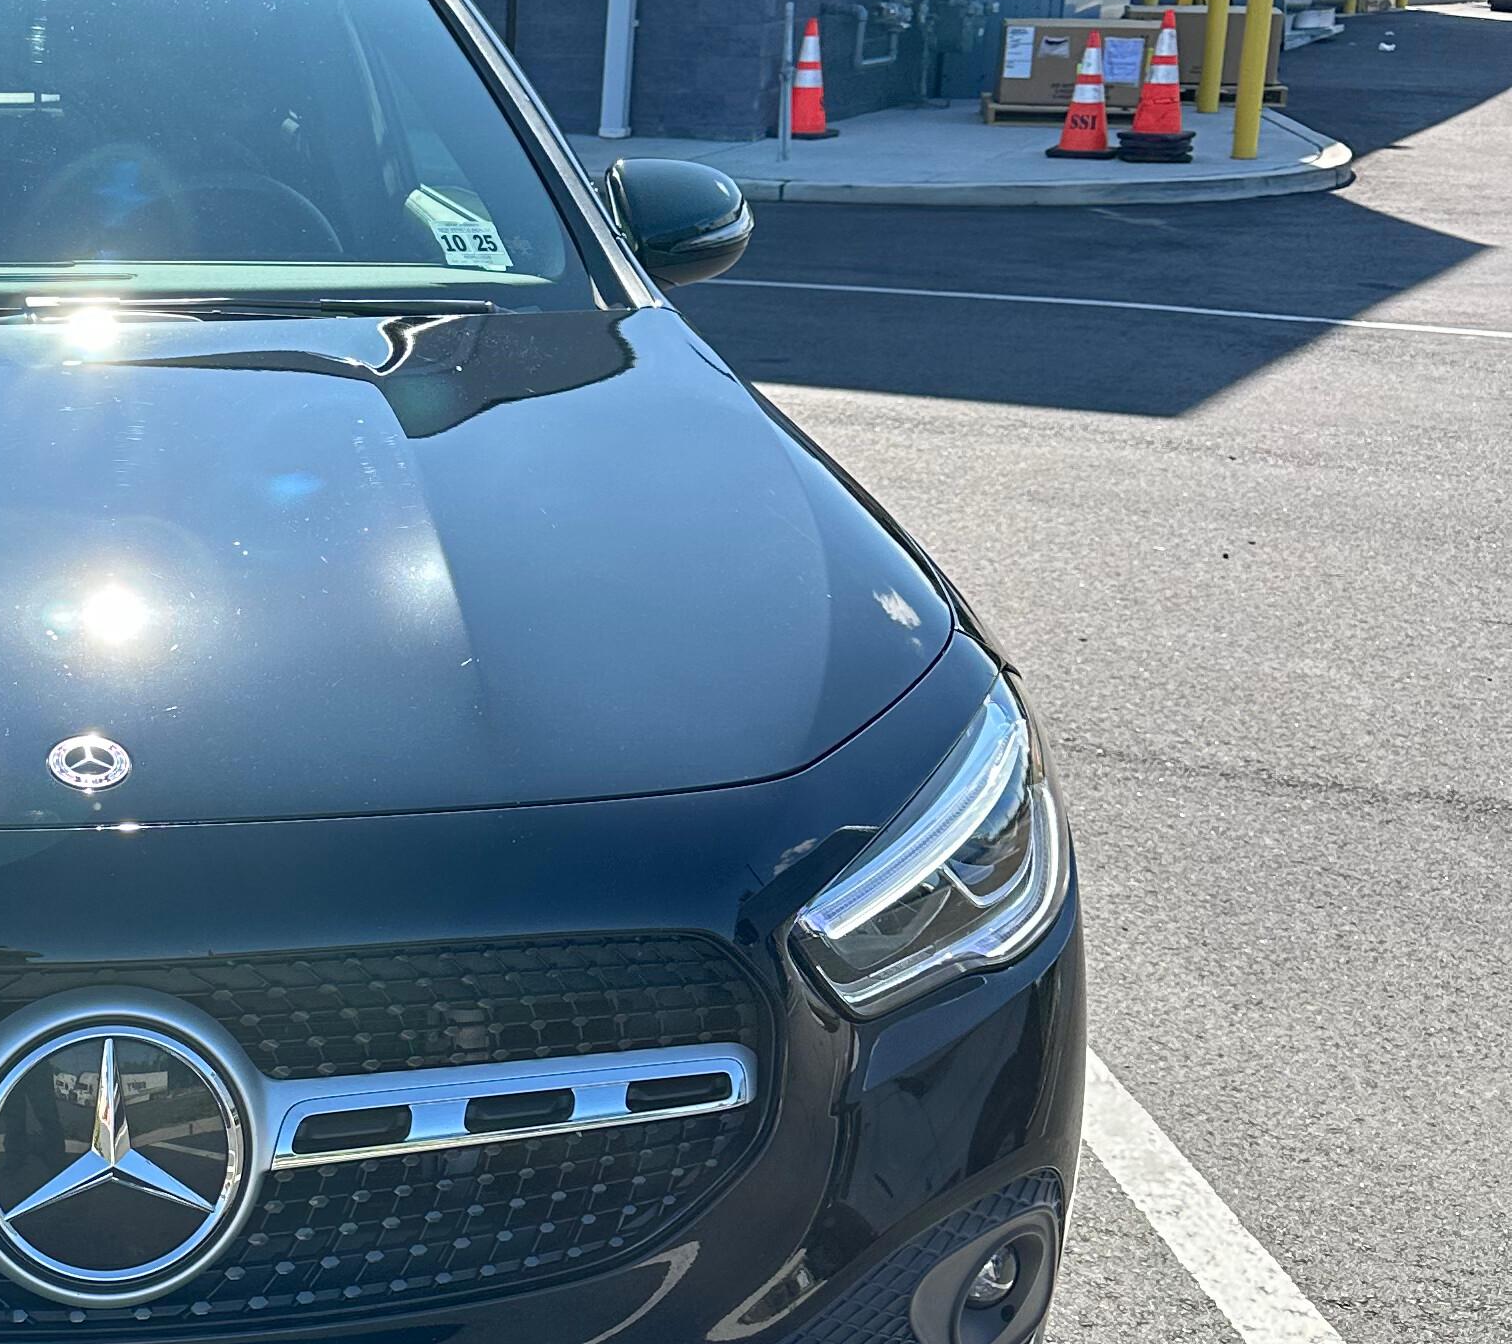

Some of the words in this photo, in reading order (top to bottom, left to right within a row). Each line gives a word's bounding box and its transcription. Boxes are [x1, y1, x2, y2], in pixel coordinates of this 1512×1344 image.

[1070, 114, 1097, 130] SSI
[441, 234, 467, 252] 10
[473, 234, 498, 252] 25
